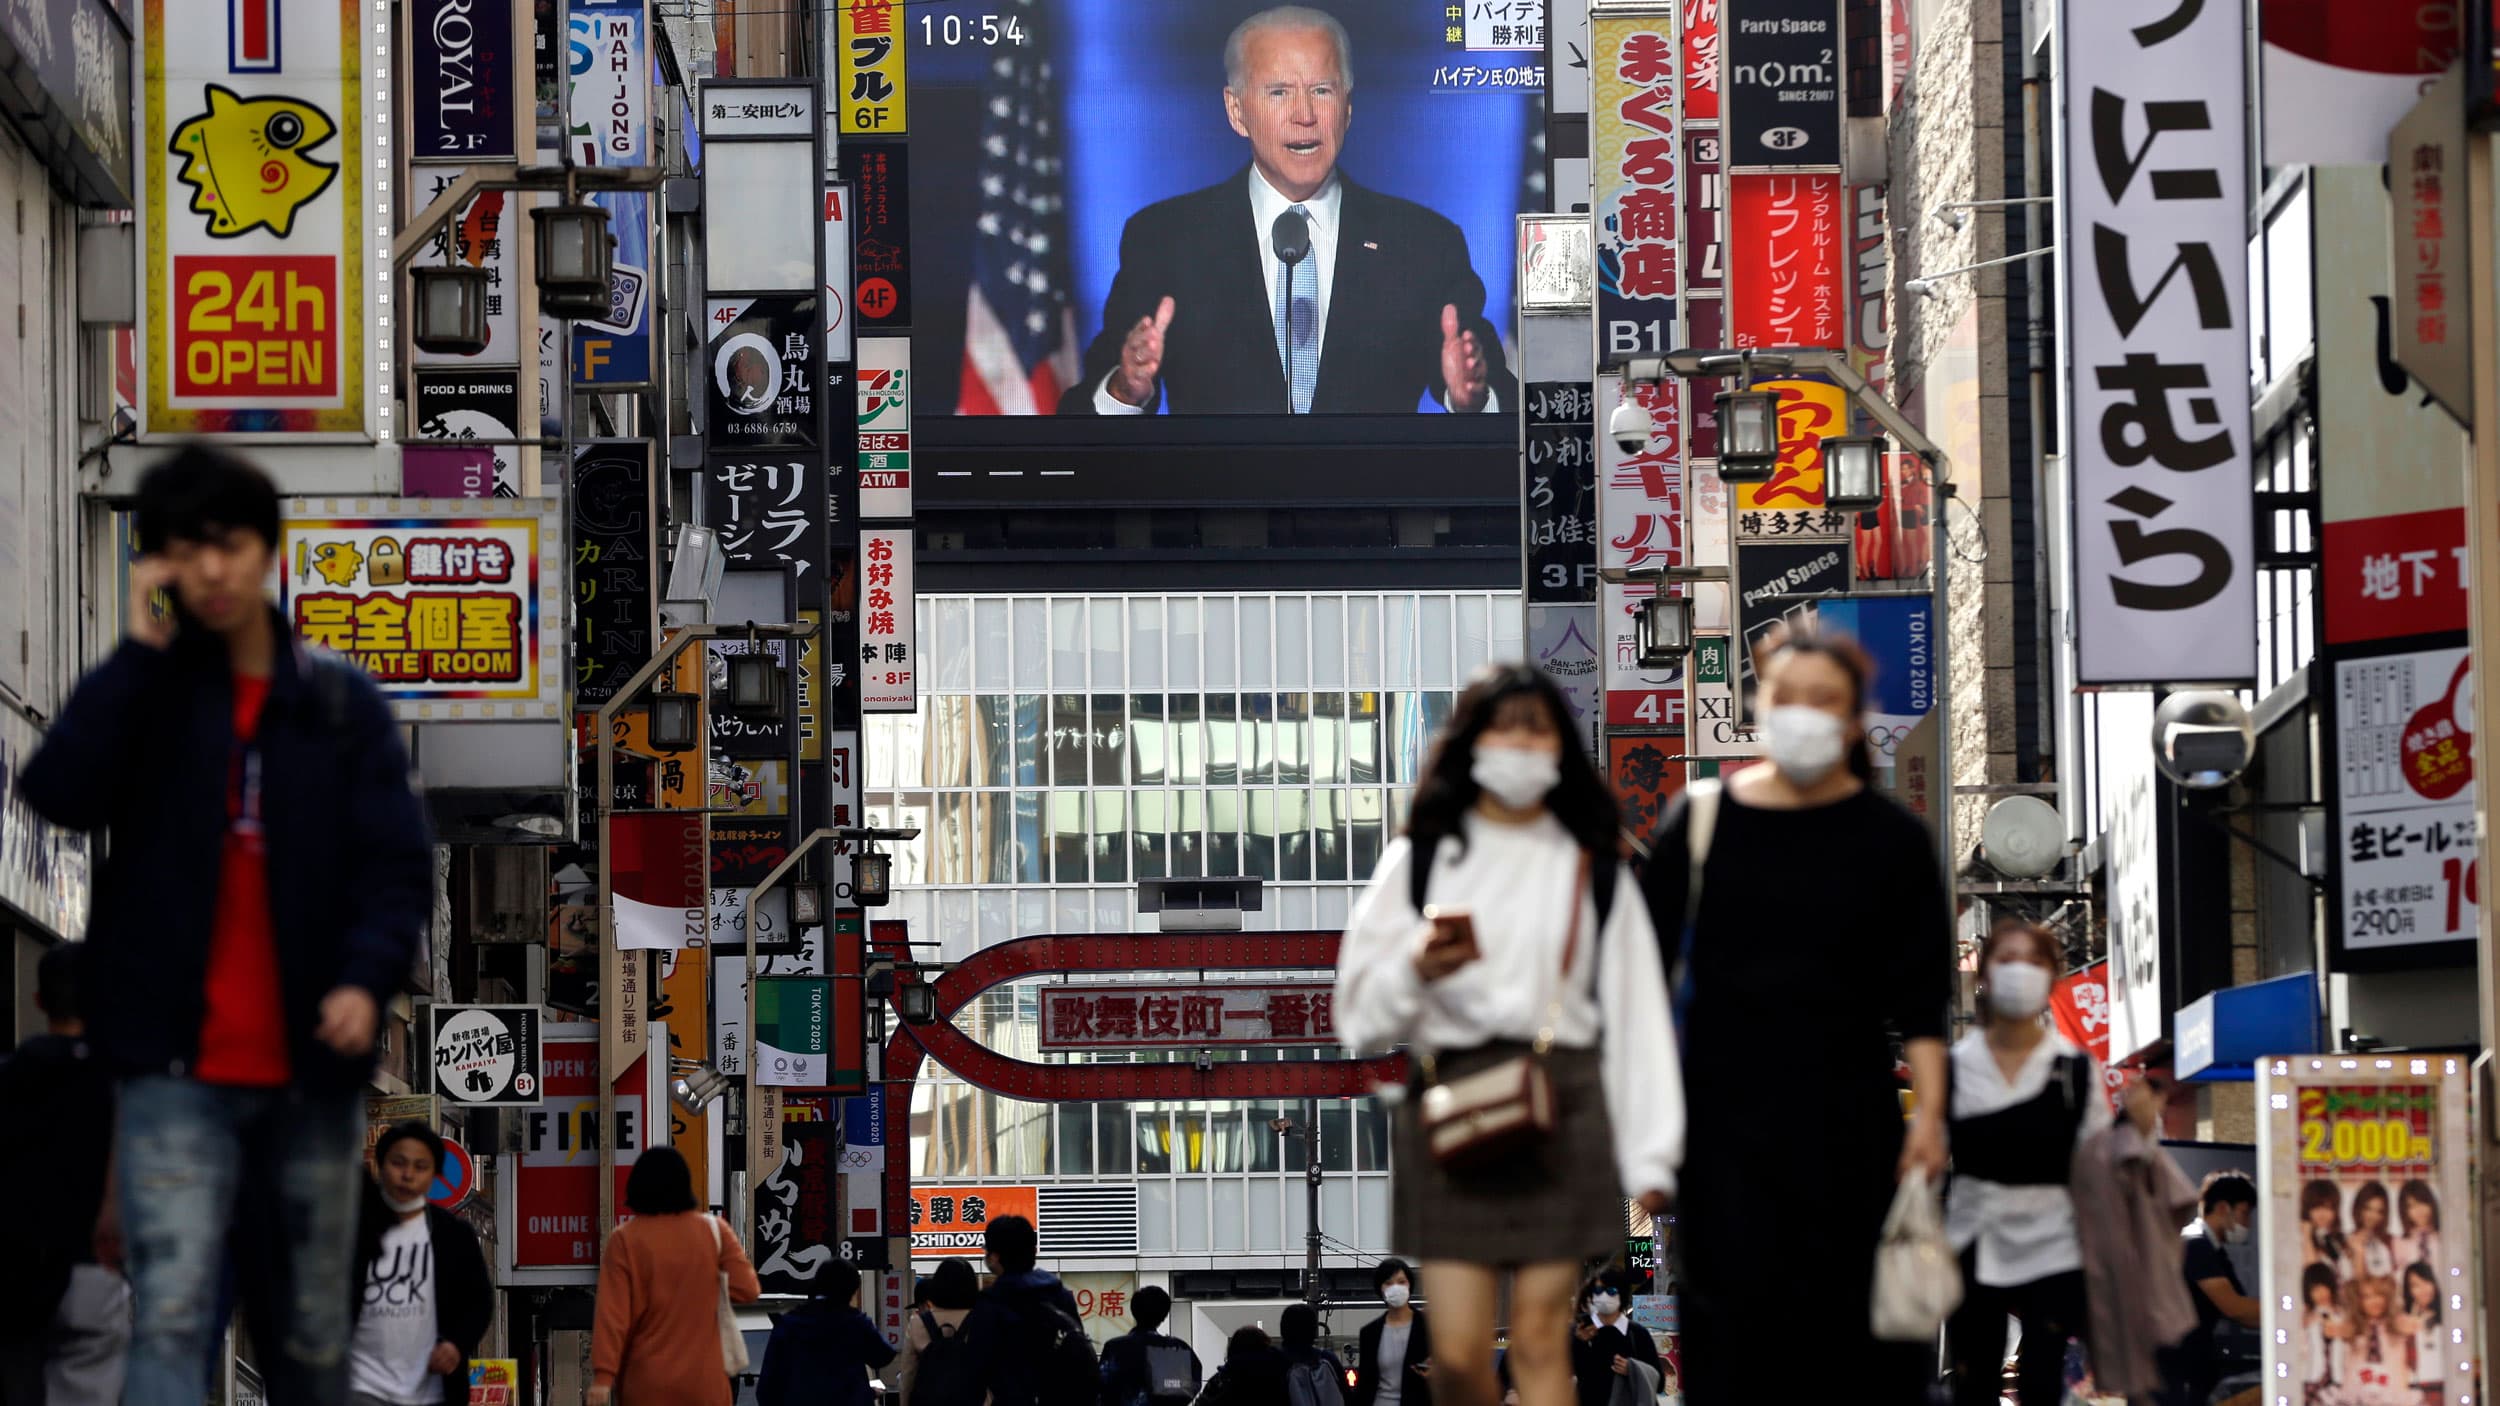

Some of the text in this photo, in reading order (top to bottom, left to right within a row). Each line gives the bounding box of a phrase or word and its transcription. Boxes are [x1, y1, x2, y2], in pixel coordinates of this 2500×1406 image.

[921, 15, 1024, 46] 10:54
[1446, 5, 1463, 42] 中継
[1741, 19, 1826, 34] Party Space
[610, 22, 629, 151] MAH-JONG
[1433, 66, 1544, 87] バイデン氏の地元
[1778, 90, 1834, 102] SINCE 2007
[711, 104, 804, 120] 第二安田ビル
[855, 107, 888, 129] 6F
[439, 134, 487, 149] 2F
[1772, 132, 1797, 147] 3F
[1619, 33, 1677, 297] まぐろ商店
[1768, 178, 1801, 347] リフレッシュ
[1812, 177, 1832, 341] レンタルルーム ホステル
[188, 270, 325, 332] 24h
[863, 289, 889, 308] 4F
[714, 307, 737, 324] 4F
[187, 340, 323, 385] OPEN
[424, 384, 513, 395] FOOD & DRINKS
[829, 375, 843, 385] 3F
[777, 396, 811, 415] 酒場
[727, 422, 797, 435] 03-6886-6759
[858, 435, 900, 449] たばこ
[829, 466, 843, 476] 3F
[869, 454, 888, 468] 酒
[860, 473, 897, 487] ATM
[1740, 511, 1844, 535] 博多天神
[409, 543, 505, 578] 鍵付き
[1744, 552, 1840, 608] Party Space
[301, 596, 513, 650] 完全個室
[576, 540, 603, 684] カリーナ
[342, 652, 513, 675] VATE ROOM
[861, 643, 907, 664] 本陣
[1551, 656, 1596, 668] BAN-THAI
[1702, 646, 1718, 664] 肉
[1908, 610, 1928, 709] TOKYO 2020
[1699, 665, 1723, 676] バル
[1633, 694, 1685, 725] 4F
[2350, 822, 2451, 862] 生ビール
[684, 890, 706, 949] 2020
[622, 949, 637, 1044] 劇場通り一番街
[811, 987, 822, 1051] TOKYO 2020
[1052, 993, 1334, 1038] 歌舞伎町一番街
[452, 1026, 490, 1043] 新宿酒場
[435, 1032, 515, 1068] カンパイ屋
[721, 1022, 740, 1073] 一番街
[455, 1058, 498, 1072] KANPAIYA
[543, 1059, 585, 1077] OPEN
[516, 1077, 532, 1090] B1
[870, 1091, 880, 1143] TOKYO 2020
[530, 1111, 635, 1150] FINE
[2301, 1120, 2431, 1162] 2,000円
[528, 1215, 588, 1233] ONLINE
[573, 1240, 592, 1258] B1
[886, 1277, 900, 1345] 劇場通り
